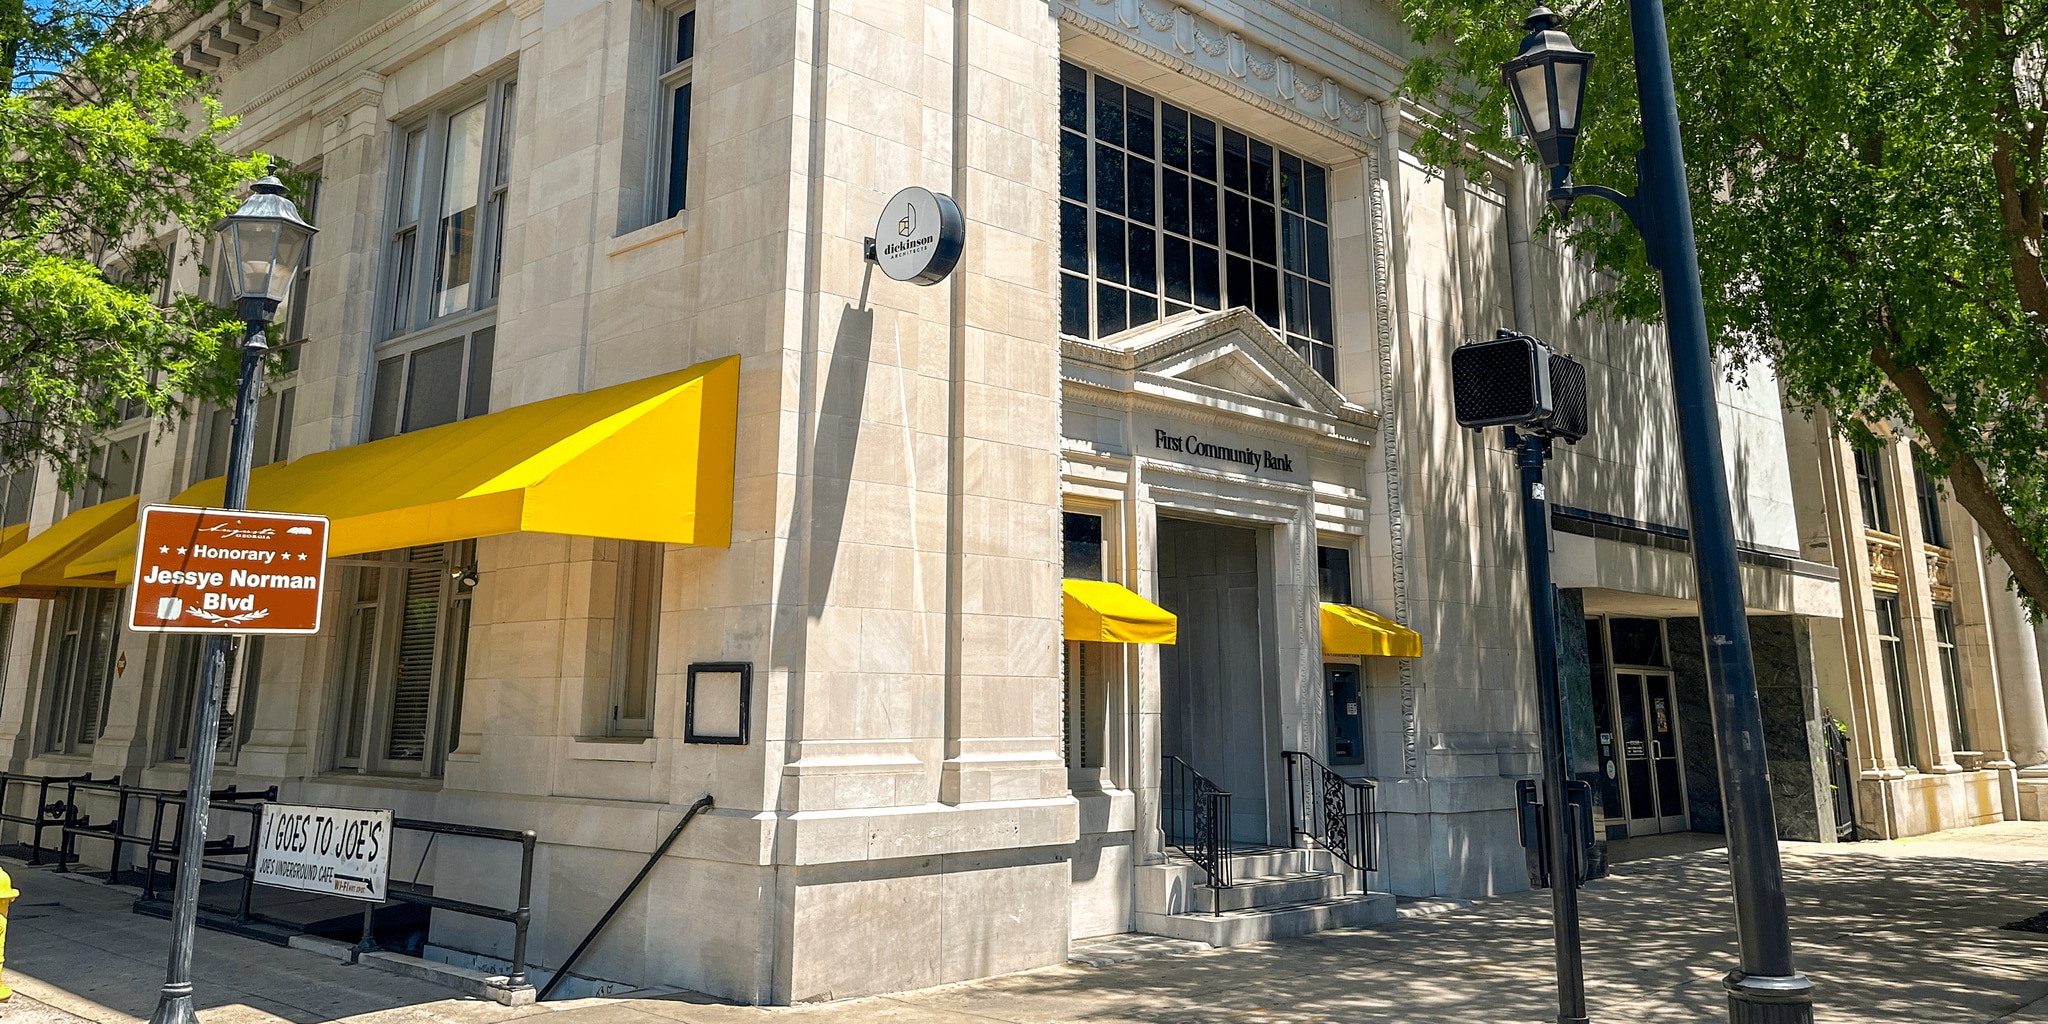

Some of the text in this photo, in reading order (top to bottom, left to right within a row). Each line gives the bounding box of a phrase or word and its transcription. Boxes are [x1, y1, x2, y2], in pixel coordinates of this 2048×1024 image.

[884, 235, 934, 255] dickinson
[890, 245, 928, 259] ARCHITECTS
[1154, 428, 1293, 472] First Community Bank
[198, 522, 276, 539] Augusta
[193, 544, 276, 564] Honorary
[143, 565, 317, 590] Jessye Norman
[203, 592, 255, 611] Blvd
[264, 813, 383, 862] I GOES TO JOE'S
[275, 861, 318, 881] UNDERGROUND
[318, 866, 335, 884] CAFE
